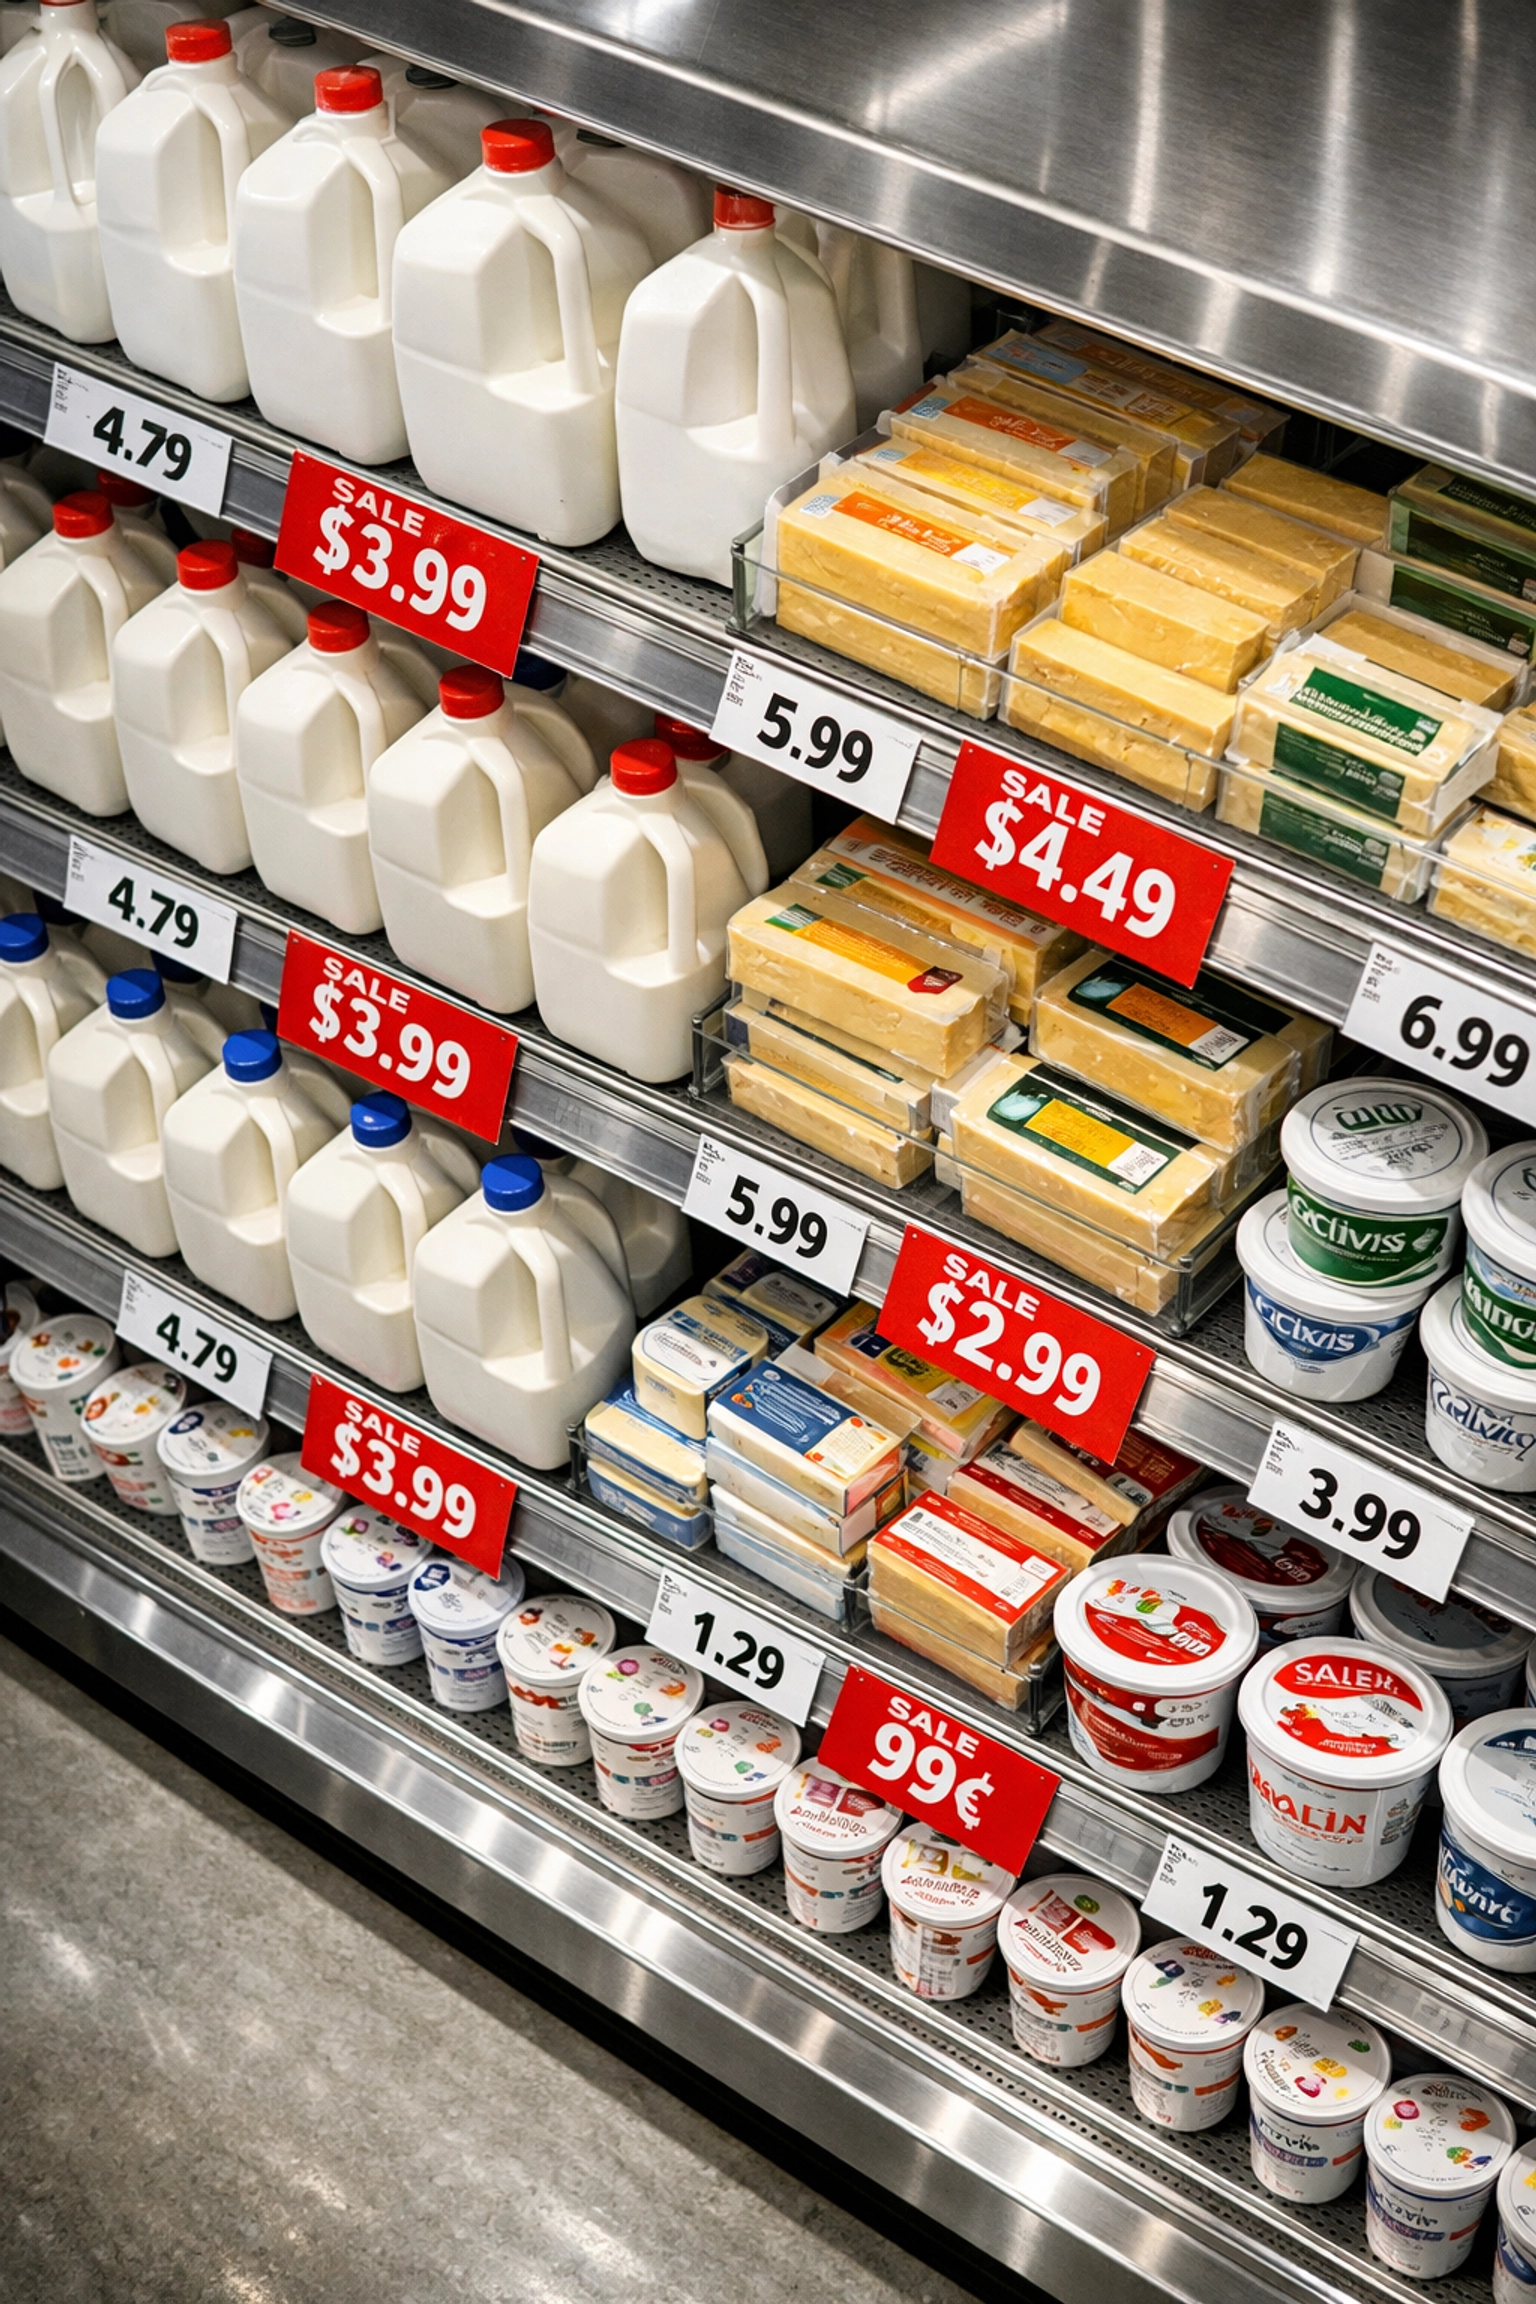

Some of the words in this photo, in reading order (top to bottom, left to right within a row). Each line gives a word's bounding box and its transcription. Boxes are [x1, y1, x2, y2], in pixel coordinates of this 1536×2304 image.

[93, 406, 192, 481] 4.79
[332, 477, 425, 537] SALE
[313, 503, 487, 632] $3.99
[756, 693, 873, 783] 5.99
[1000, 769, 1106, 837] SALE
[974, 797, 1176, 938] $4.49
[108, 876, 199, 949] 4.79
[323, 957, 411, 1014] SALE
[309, 979, 471, 1099] $3.99
[1400, 995, 1530, 1088] 6.99
[725, 1174, 828, 1259] 5.99
[943, 1253, 1040, 1321] SALE
[156, 1313, 237, 1383] 4.79
[916, 1280, 1102, 1416] $2.99
[345, 1400, 421, 1457] SALE
[330, 1421, 476, 1539] $3.99
[1298, 1468, 1421, 1560] 3.99
[694, 1612, 785, 1690] 1.29
[887, 1696, 980, 1759] SALE
[1201, 1883, 1308, 1970] 1.29
